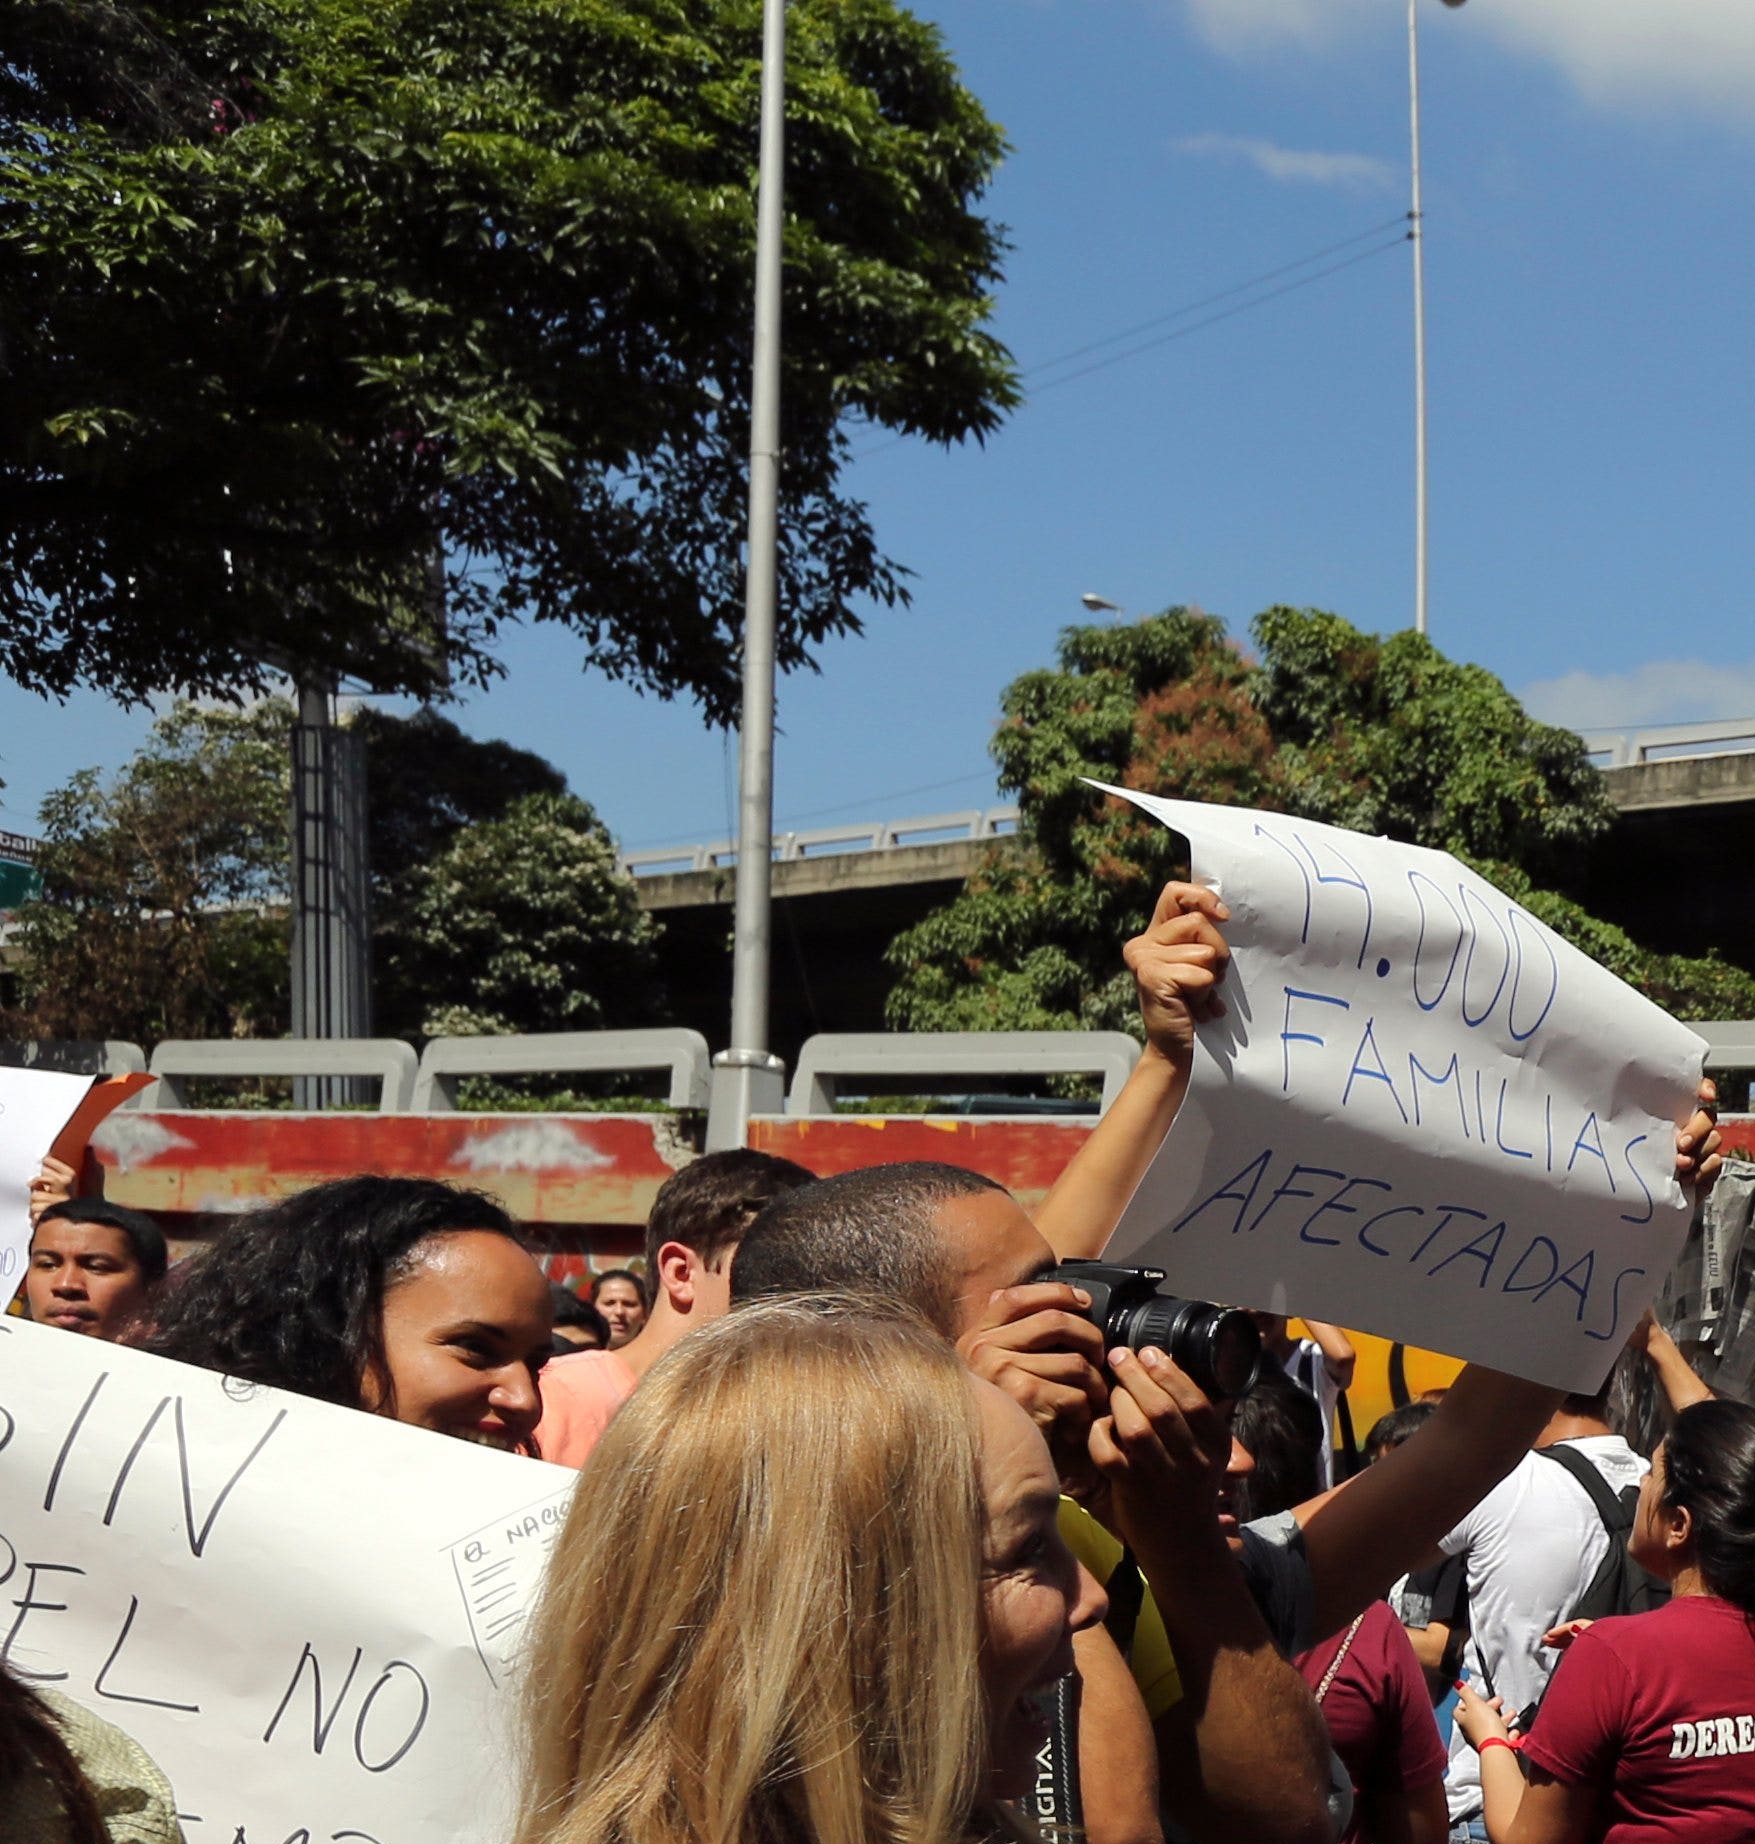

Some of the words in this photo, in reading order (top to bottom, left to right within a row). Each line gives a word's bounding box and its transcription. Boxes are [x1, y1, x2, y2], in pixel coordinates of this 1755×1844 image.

[1254, 824, 1558, 1041] 14.000
[1280, 986, 1655, 1224] FAMILIAS
[1172, 1149, 1646, 1340] AFECTADAS
[0, 1328, 288, 1558] IN
[0, 1535, 200, 1713] EL
[262, 1641, 430, 1774] NO
